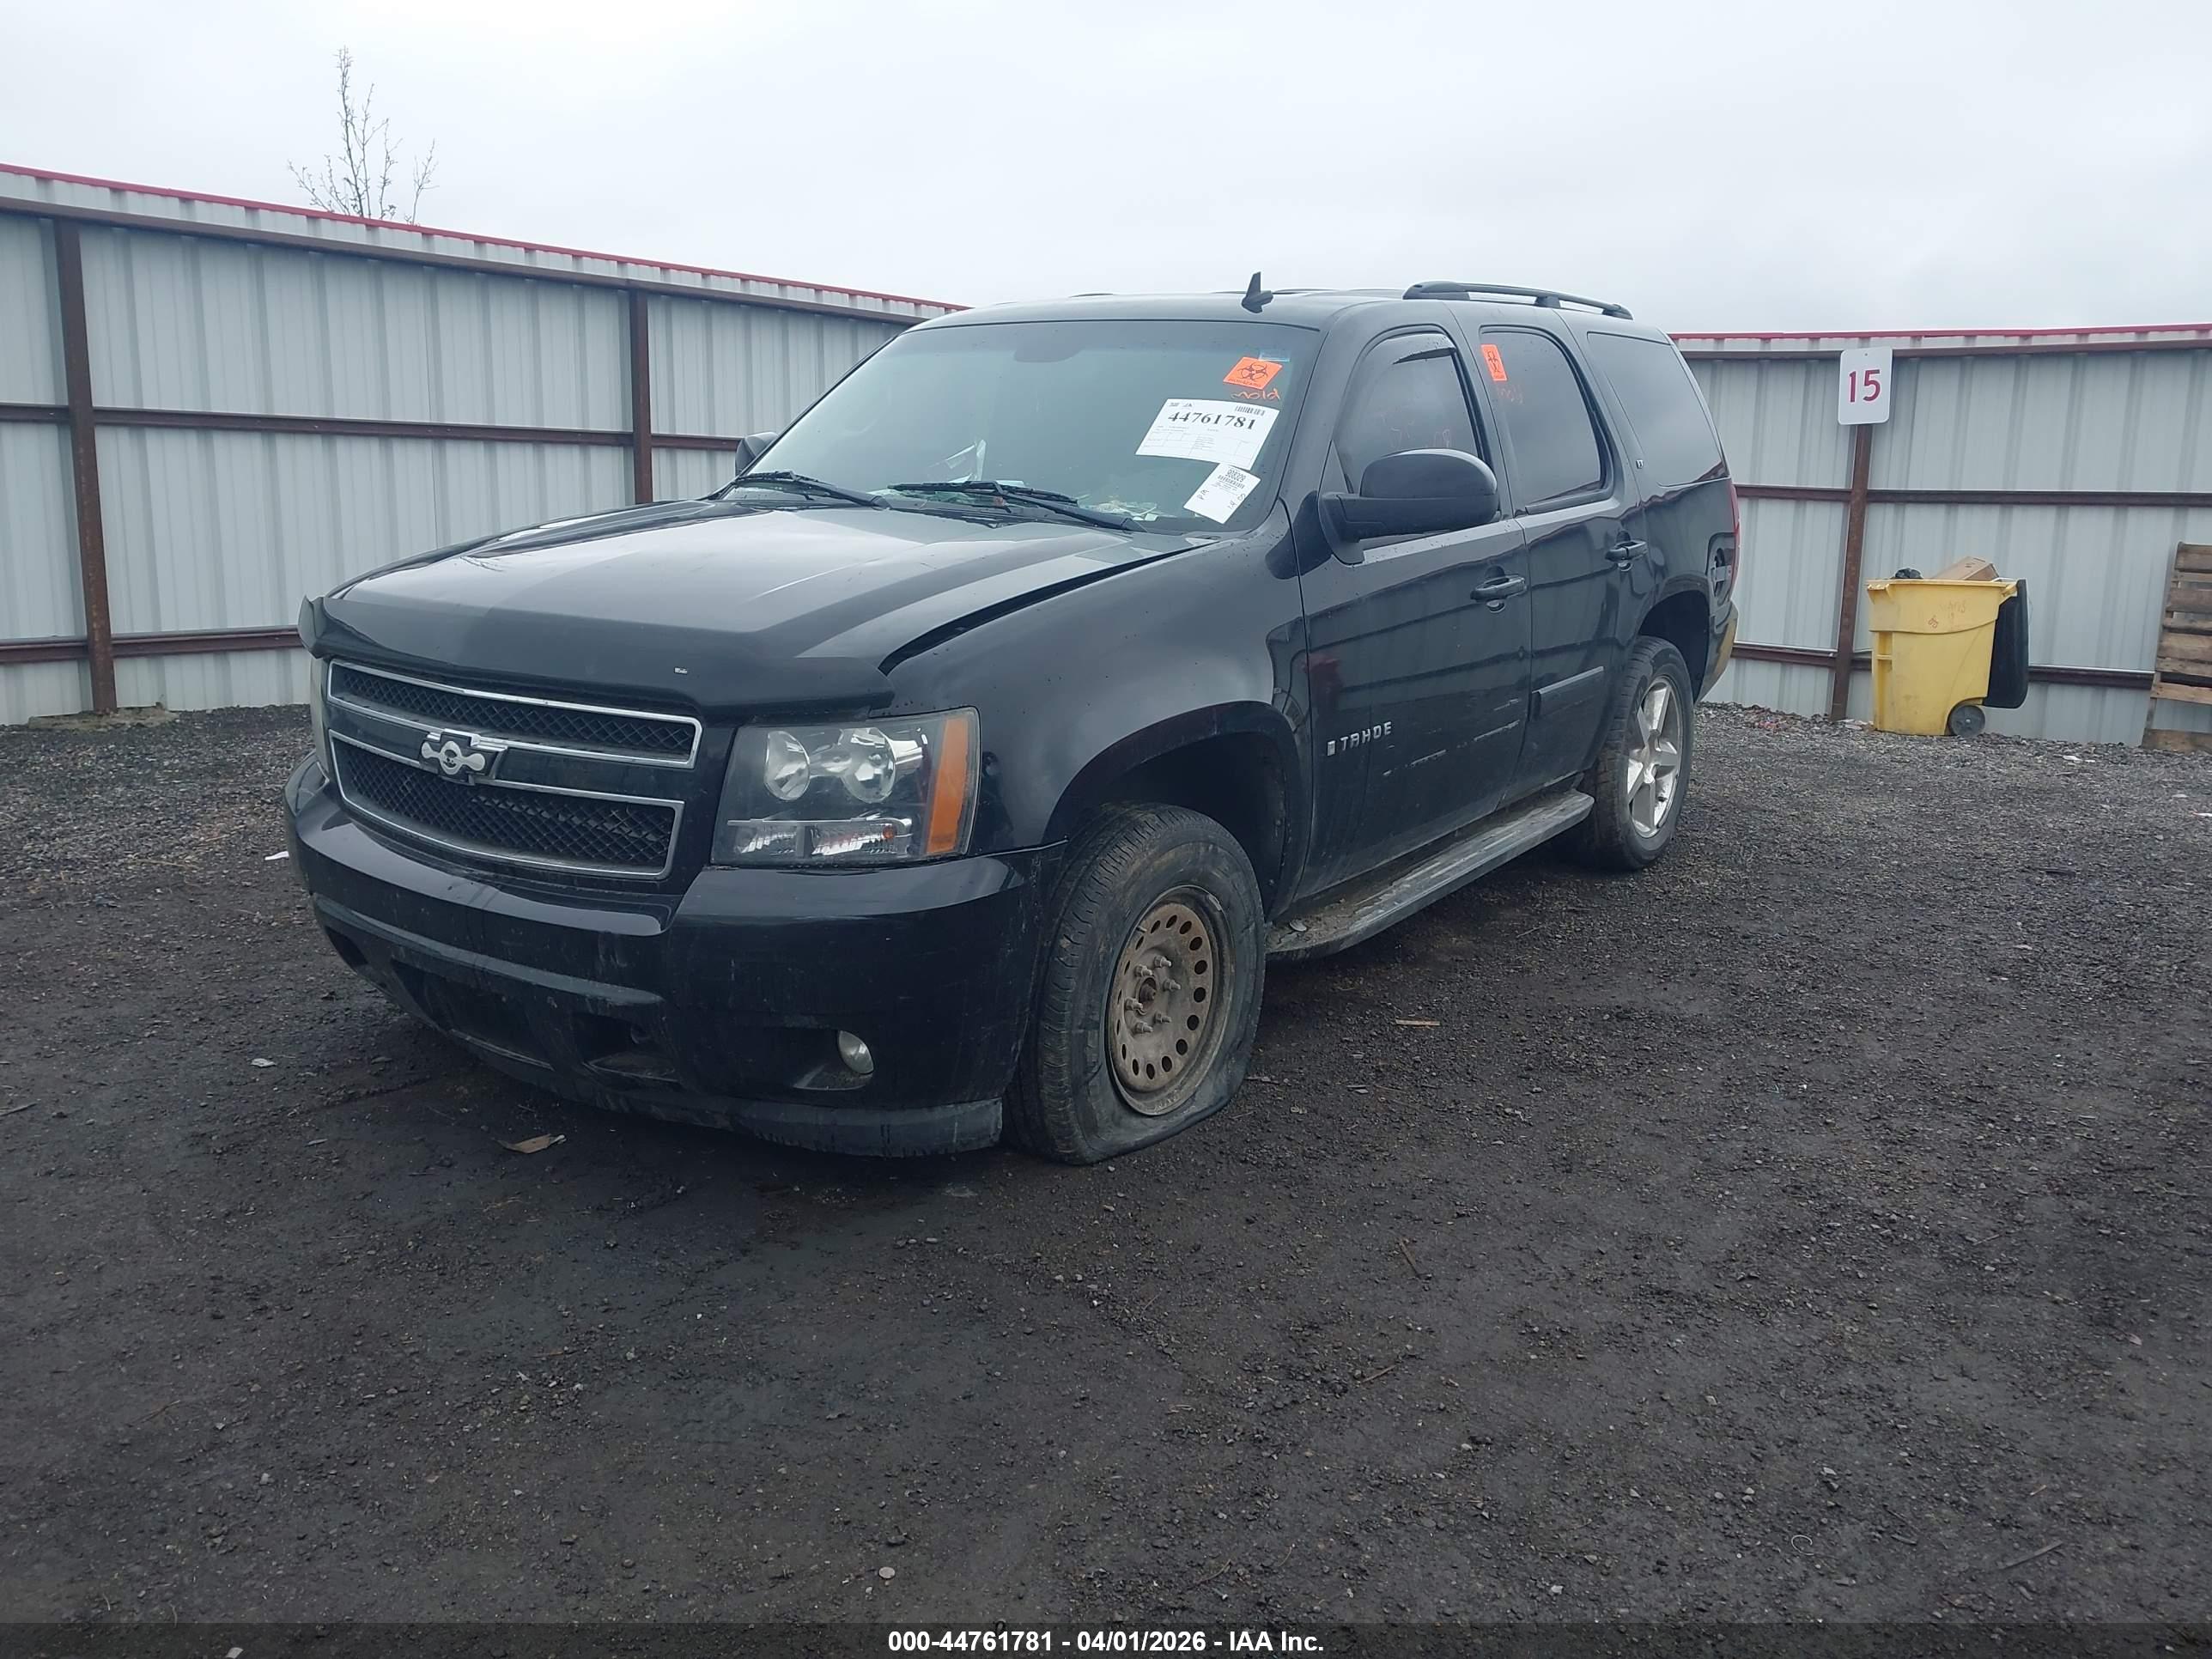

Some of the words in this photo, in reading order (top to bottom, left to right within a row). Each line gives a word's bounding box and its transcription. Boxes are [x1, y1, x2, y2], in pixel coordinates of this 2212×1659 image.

[1849, 369, 1881, 403] 15
[1168, 411, 1255, 430] 44761781
[1340, 721, 1392, 751] TAHOE
